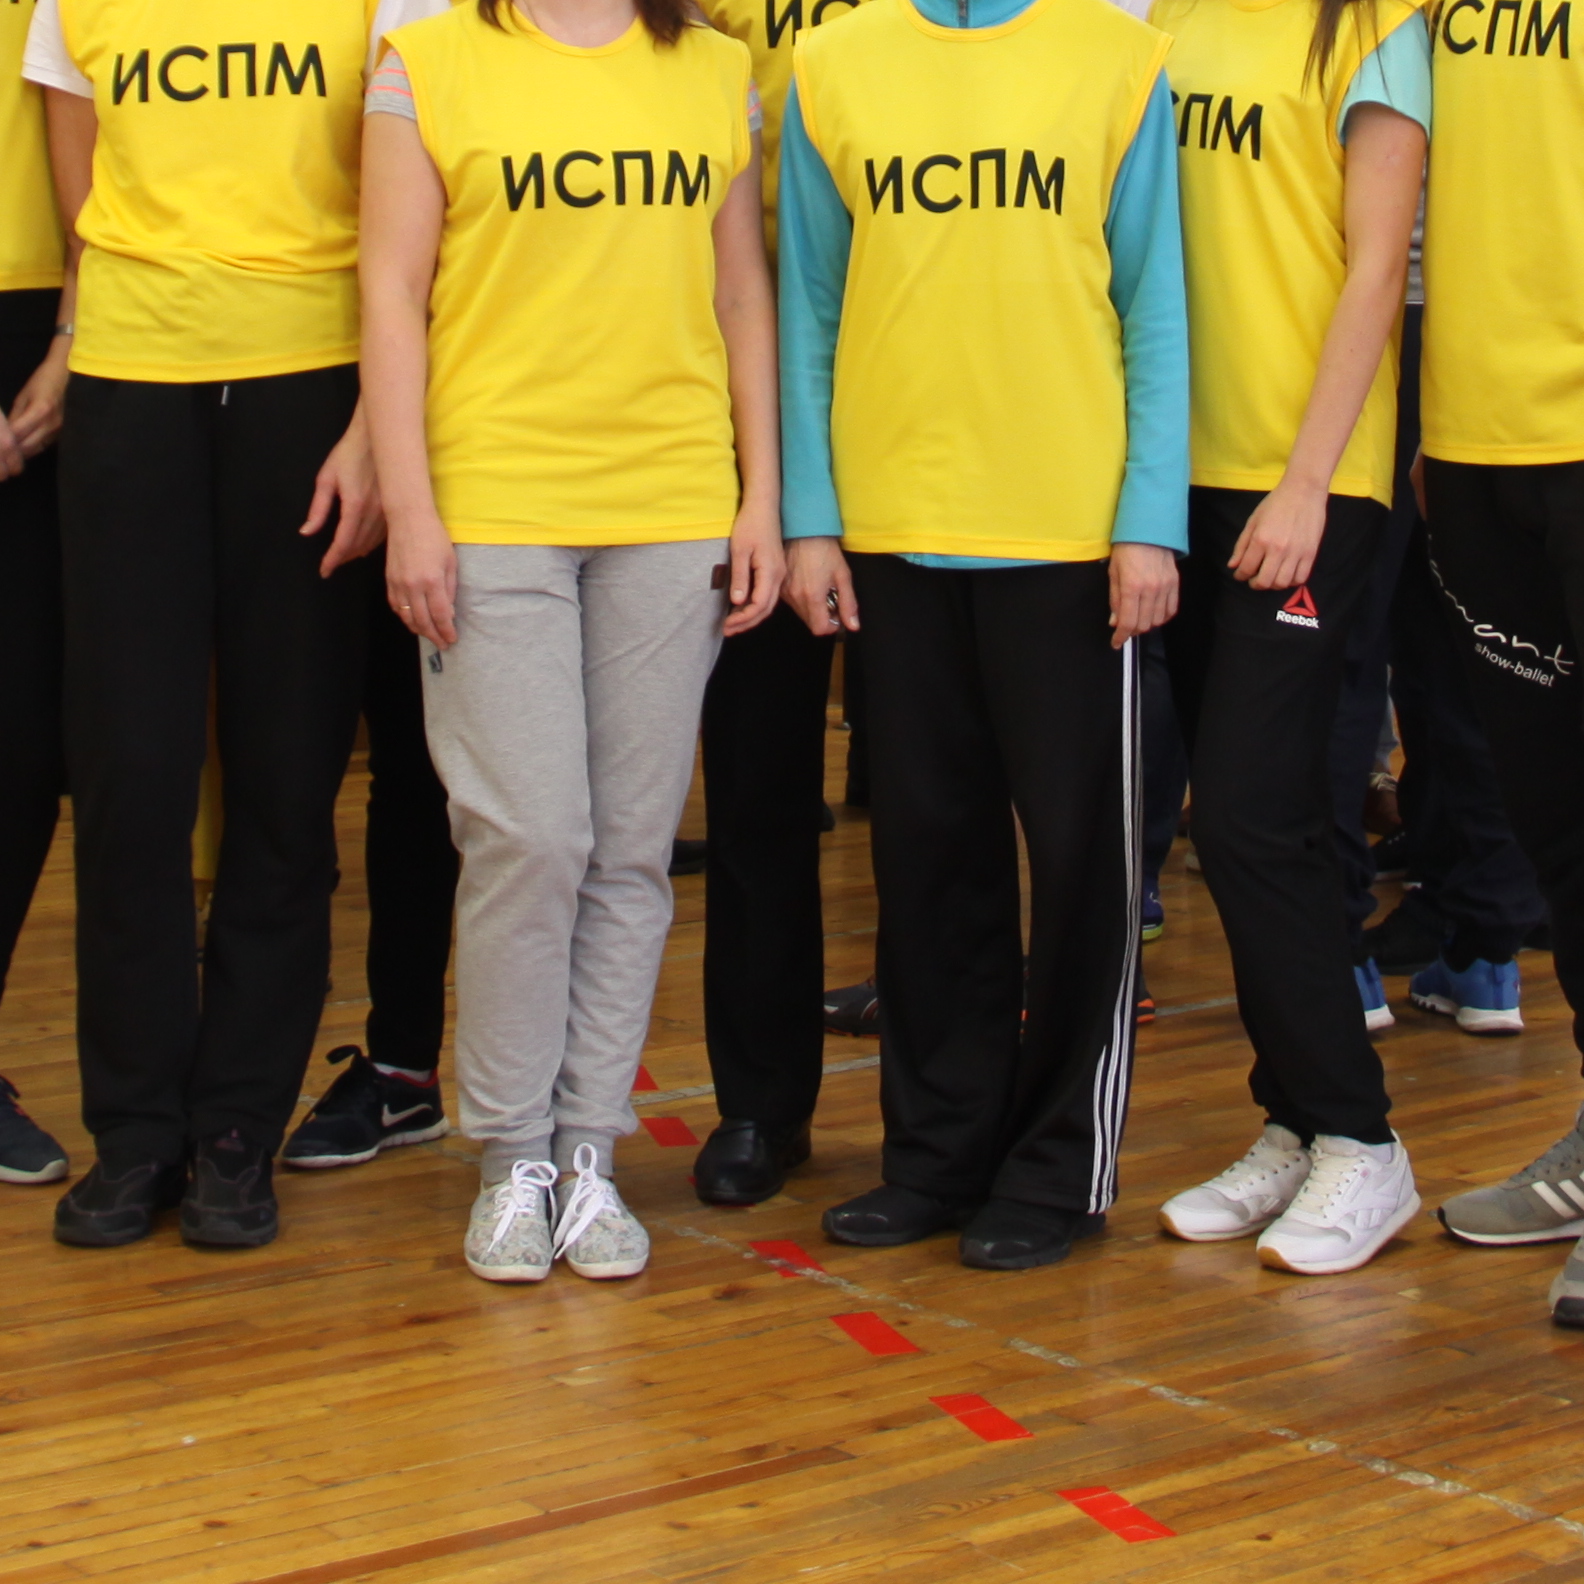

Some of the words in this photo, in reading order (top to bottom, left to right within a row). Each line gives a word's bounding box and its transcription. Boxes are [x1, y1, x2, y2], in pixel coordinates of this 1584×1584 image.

[112, 42, 327, 106] ИСПМ
[501, 149, 710, 212] ИСПМ
[864, 147, 1066, 216] ИСПМ
[1276, 609, 1320, 629] Reebok
[1474, 642, 1556, 687] show-ballet
